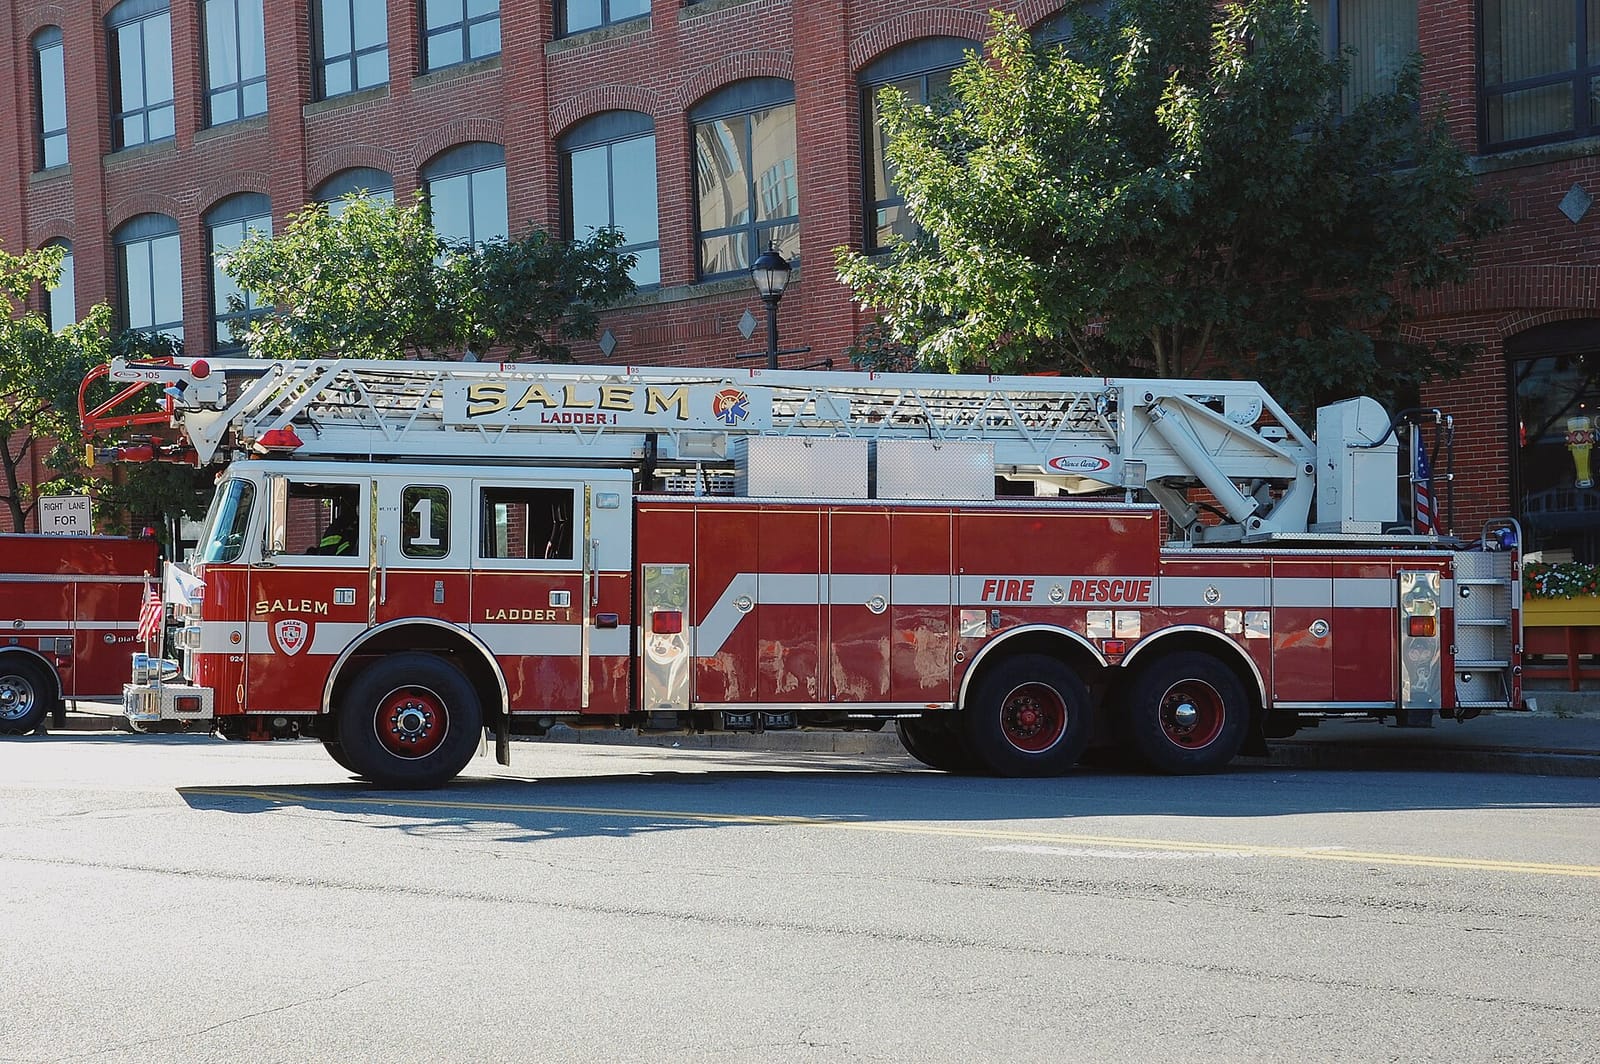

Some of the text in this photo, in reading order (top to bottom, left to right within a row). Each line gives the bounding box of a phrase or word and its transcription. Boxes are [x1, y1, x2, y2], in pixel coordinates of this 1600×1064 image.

[145, 371, 160, 379] 105
[466, 382, 690, 422] SALEM
[540, 412, 617, 424] LADDER 1
[43, 502, 86, 511] RIGHT LANE
[54, 515, 77, 525] FOR
[411, 498, 440, 545] 1
[981, 579, 1152, 602] FIRE RESCUE
[255, 599, 328, 615] SALEM
[485, 609, 570, 621] LADDER 1
[118, 635, 134, 643] Dial
